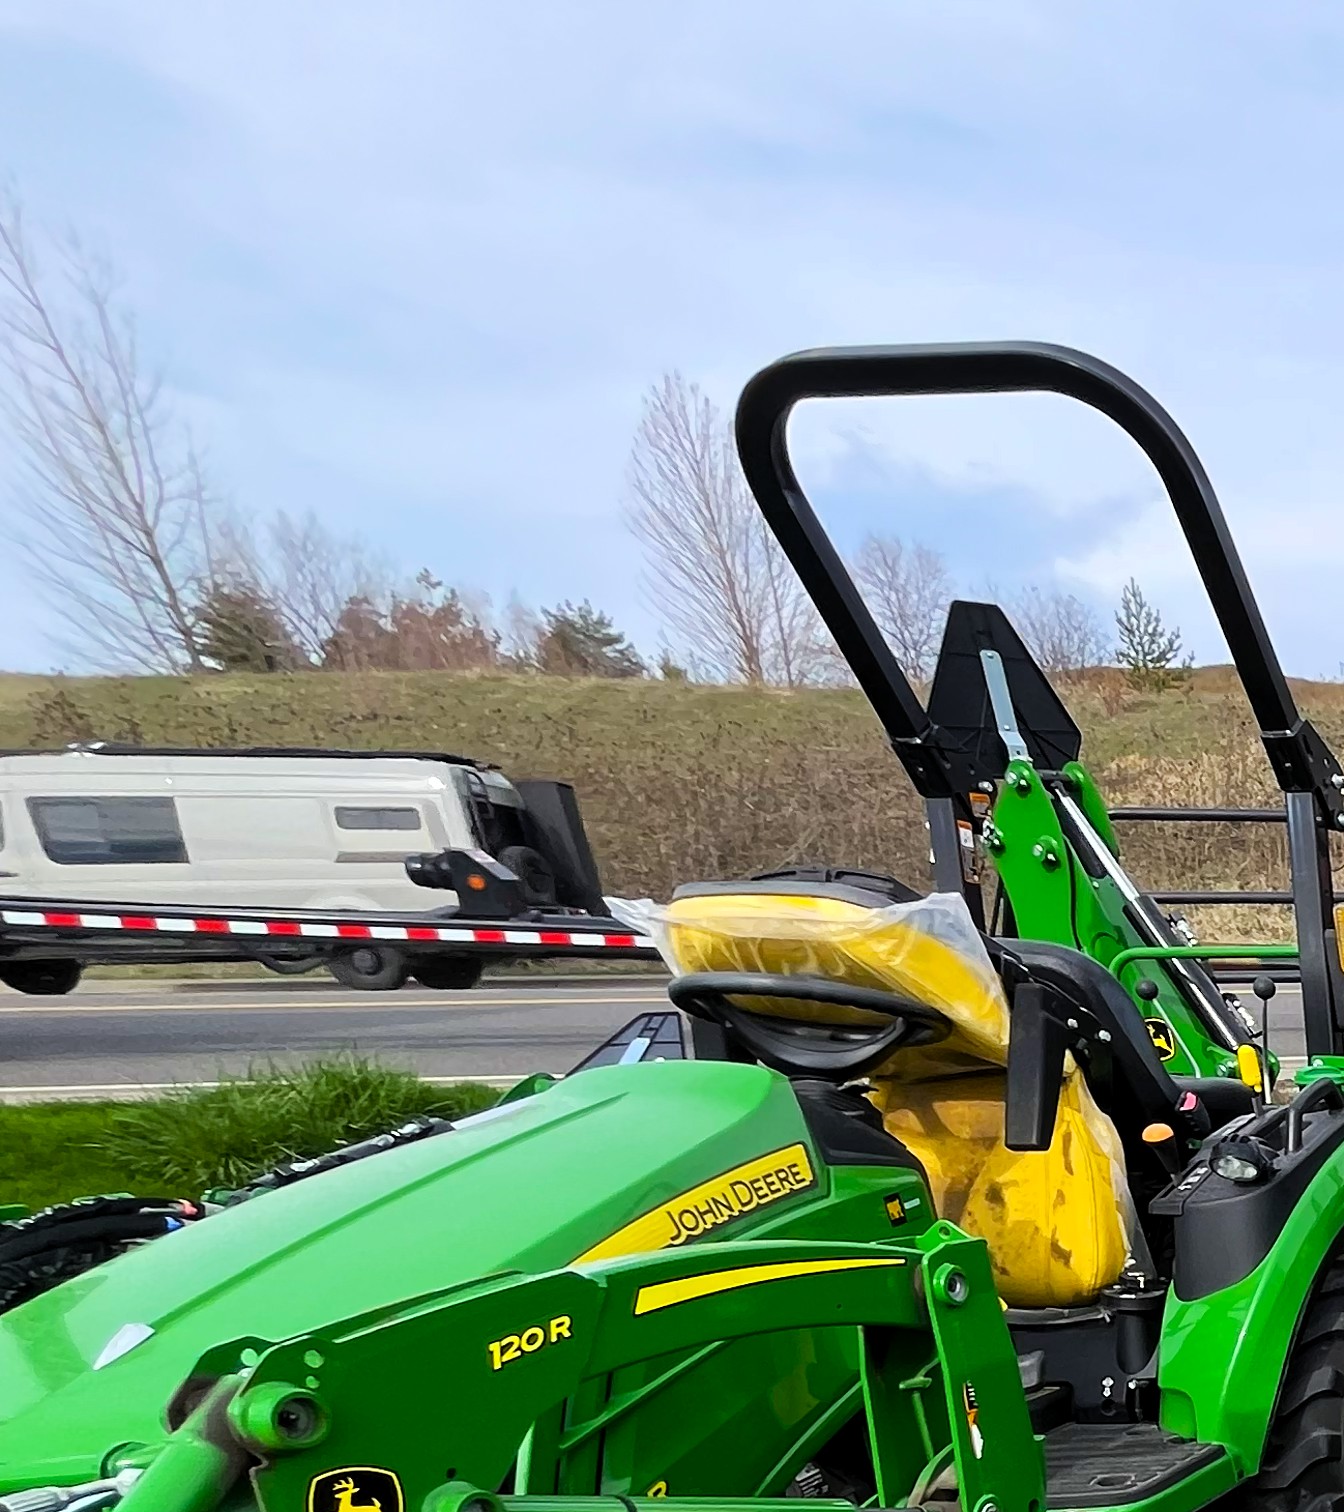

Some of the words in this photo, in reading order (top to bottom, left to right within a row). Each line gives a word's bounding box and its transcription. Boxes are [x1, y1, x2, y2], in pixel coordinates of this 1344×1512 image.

[666, 1192, 738, 1242] JOHN
[729, 1162, 808, 1210] DEERE
[488, 1327, 545, 1370] 120
[549, 1315, 571, 1343] R
